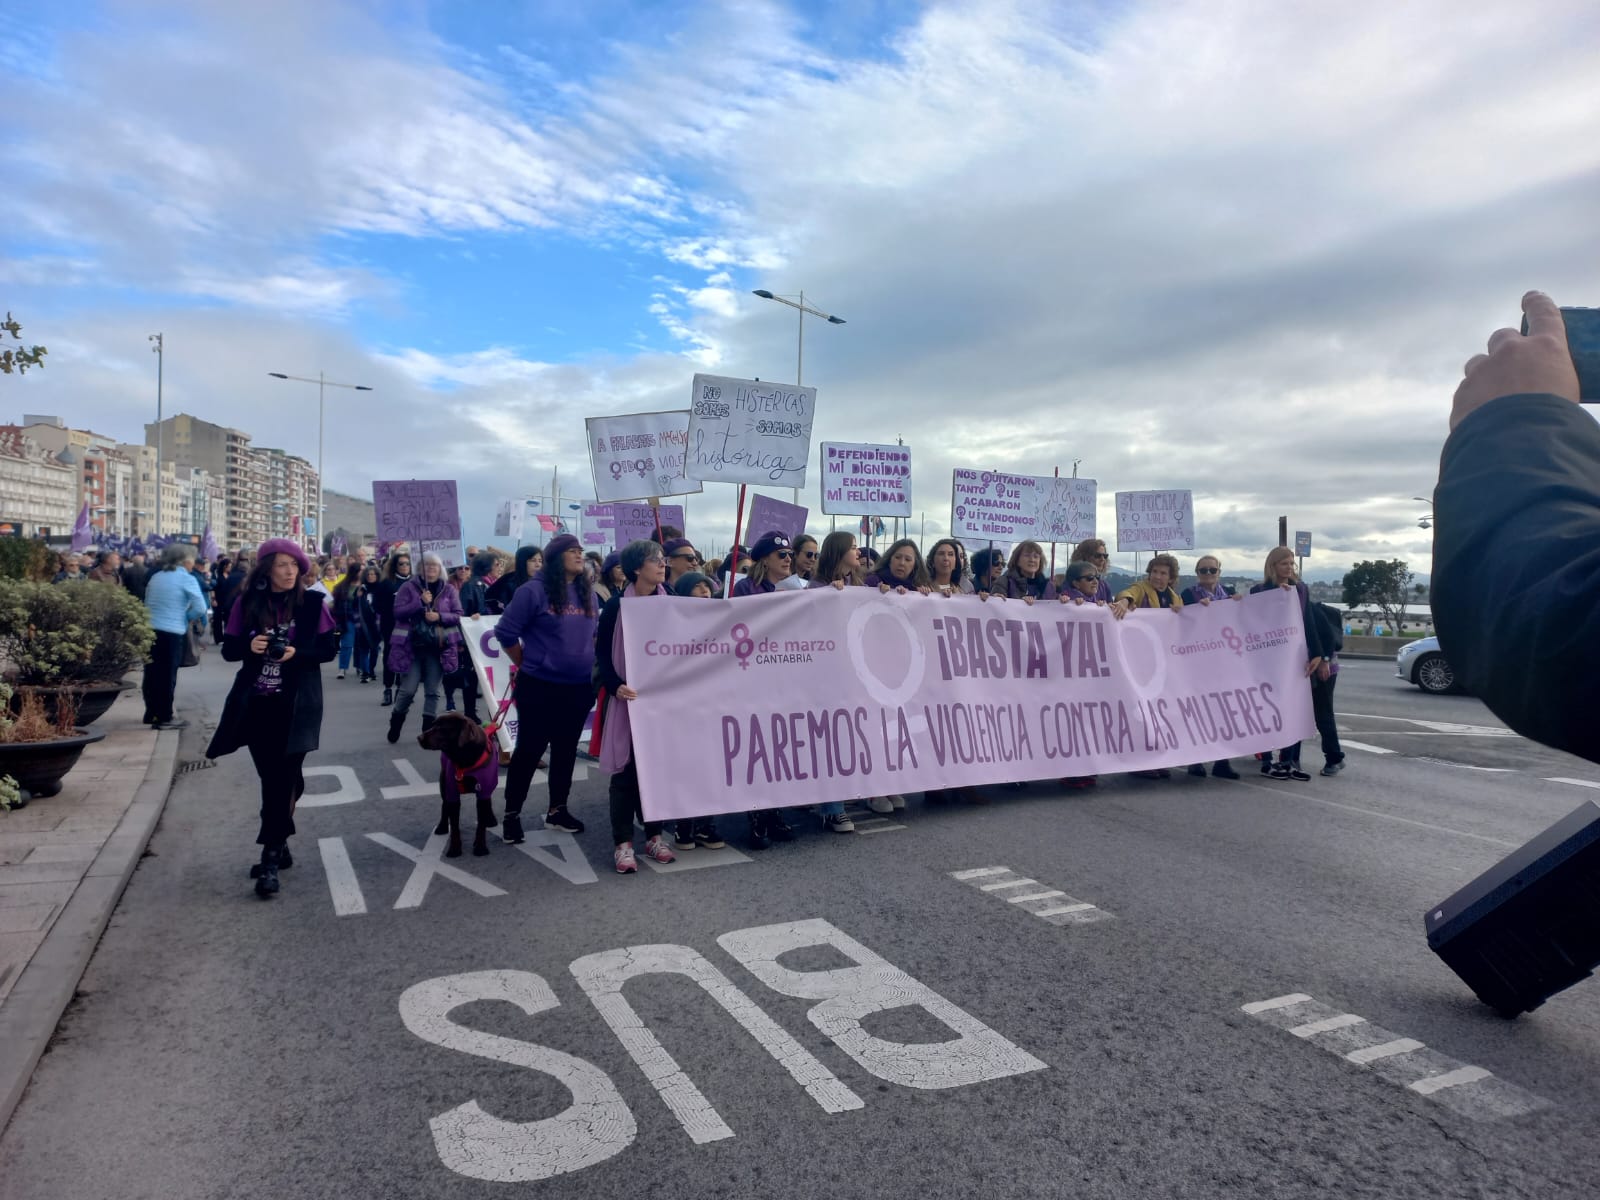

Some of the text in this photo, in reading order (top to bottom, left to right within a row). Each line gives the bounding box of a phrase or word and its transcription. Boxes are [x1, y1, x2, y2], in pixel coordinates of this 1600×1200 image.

[703, 386, 721, 399] NO
[694, 401, 729, 417] SOMOS
[756, 420, 801, 437] SOMOS
[598, 438, 606, 453] A
[828, 448, 909, 462] DEFENDIENDO
[829, 461, 911, 479] MI DIGNIDAD,
[842, 477, 902, 488] ENCONTRÉ
[956, 470, 1036, 488] NOS QUITARON
[827, 488, 908, 503] MI FELICIDAD.
[956, 483, 1020, 498] TANTO QUE
[964, 497, 1021, 510] ACABARON
[956, 506, 1036, 525] QUITANDONOS
[966, 522, 1014, 534] EL MIEDO
[644, 623, 836, 671] Comisión 8 de marzo
[933, 616, 1111, 680] ¡BASTA YA!
[1170, 638, 1227, 656] Comisión
[1244, 632, 1260, 644] de
[1264, 626, 1299, 640] marzo
[1245, 637, 1288, 652] CANTABRIA
[756, 653, 813, 665] CANTABRIA
[722, 682, 1283, 786] PAREMOS LA VIOLENCIA CONTRA LAS MUJERES
[398, 918, 1050, 1183] BUS
